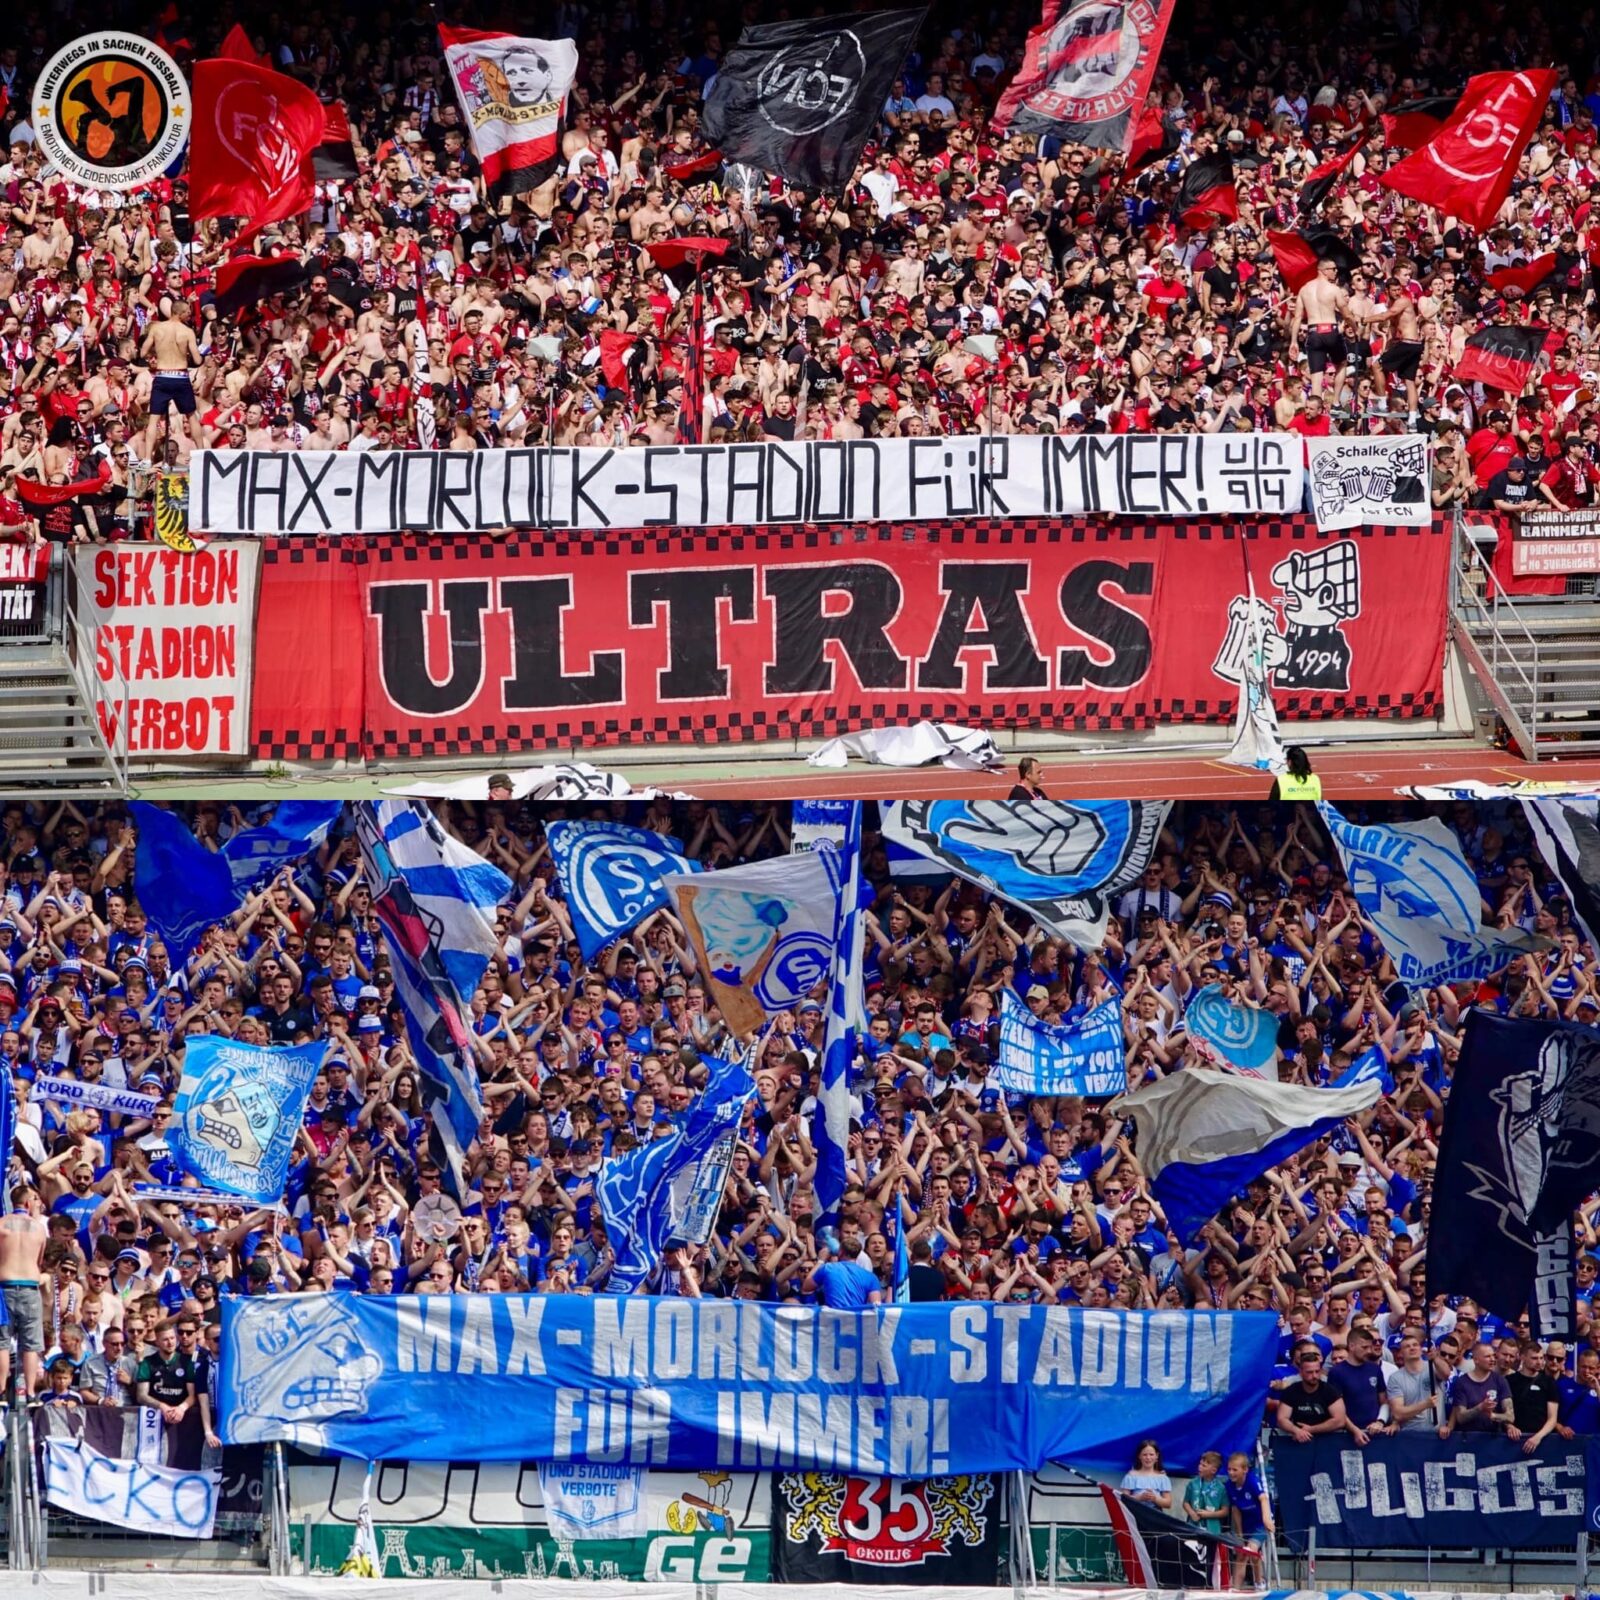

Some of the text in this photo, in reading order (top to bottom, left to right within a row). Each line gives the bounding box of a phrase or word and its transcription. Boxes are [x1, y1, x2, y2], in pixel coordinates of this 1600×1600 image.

[1336, 445, 1388, 458] Schalke
[202, 436, 1208, 531] MAX-MORLOCK-STADION FÜR IMMER!
[1362, 466, 1370, 477] &
[1385, 506, 1413, 516] FCN
[0, 543, 38, 578] EKT
[95, 549, 238, 608] SEKTION
[1529, 560, 1540, 570] NO
[0, 584, 36, 620] TÄT
[96, 623, 236, 682] STADION
[368, 557, 1154, 718] ULTRAS
[1295, 649, 1342, 676] 1994
[96, 695, 235, 751] VERBOT
[36, 1081, 84, 1098] NORD
[396, 1296, 1232, 1393] MAX-MORLOCK-STADION
[553, 1388, 950, 1476] FÜR IMMER!
[550, 1465, 574, 1478] UND
[561, 1481, 617, 1497] VERBOTE
[1304, 1449, 1586, 1526] HUGOS
[844, 1475, 930, 1542] 35
